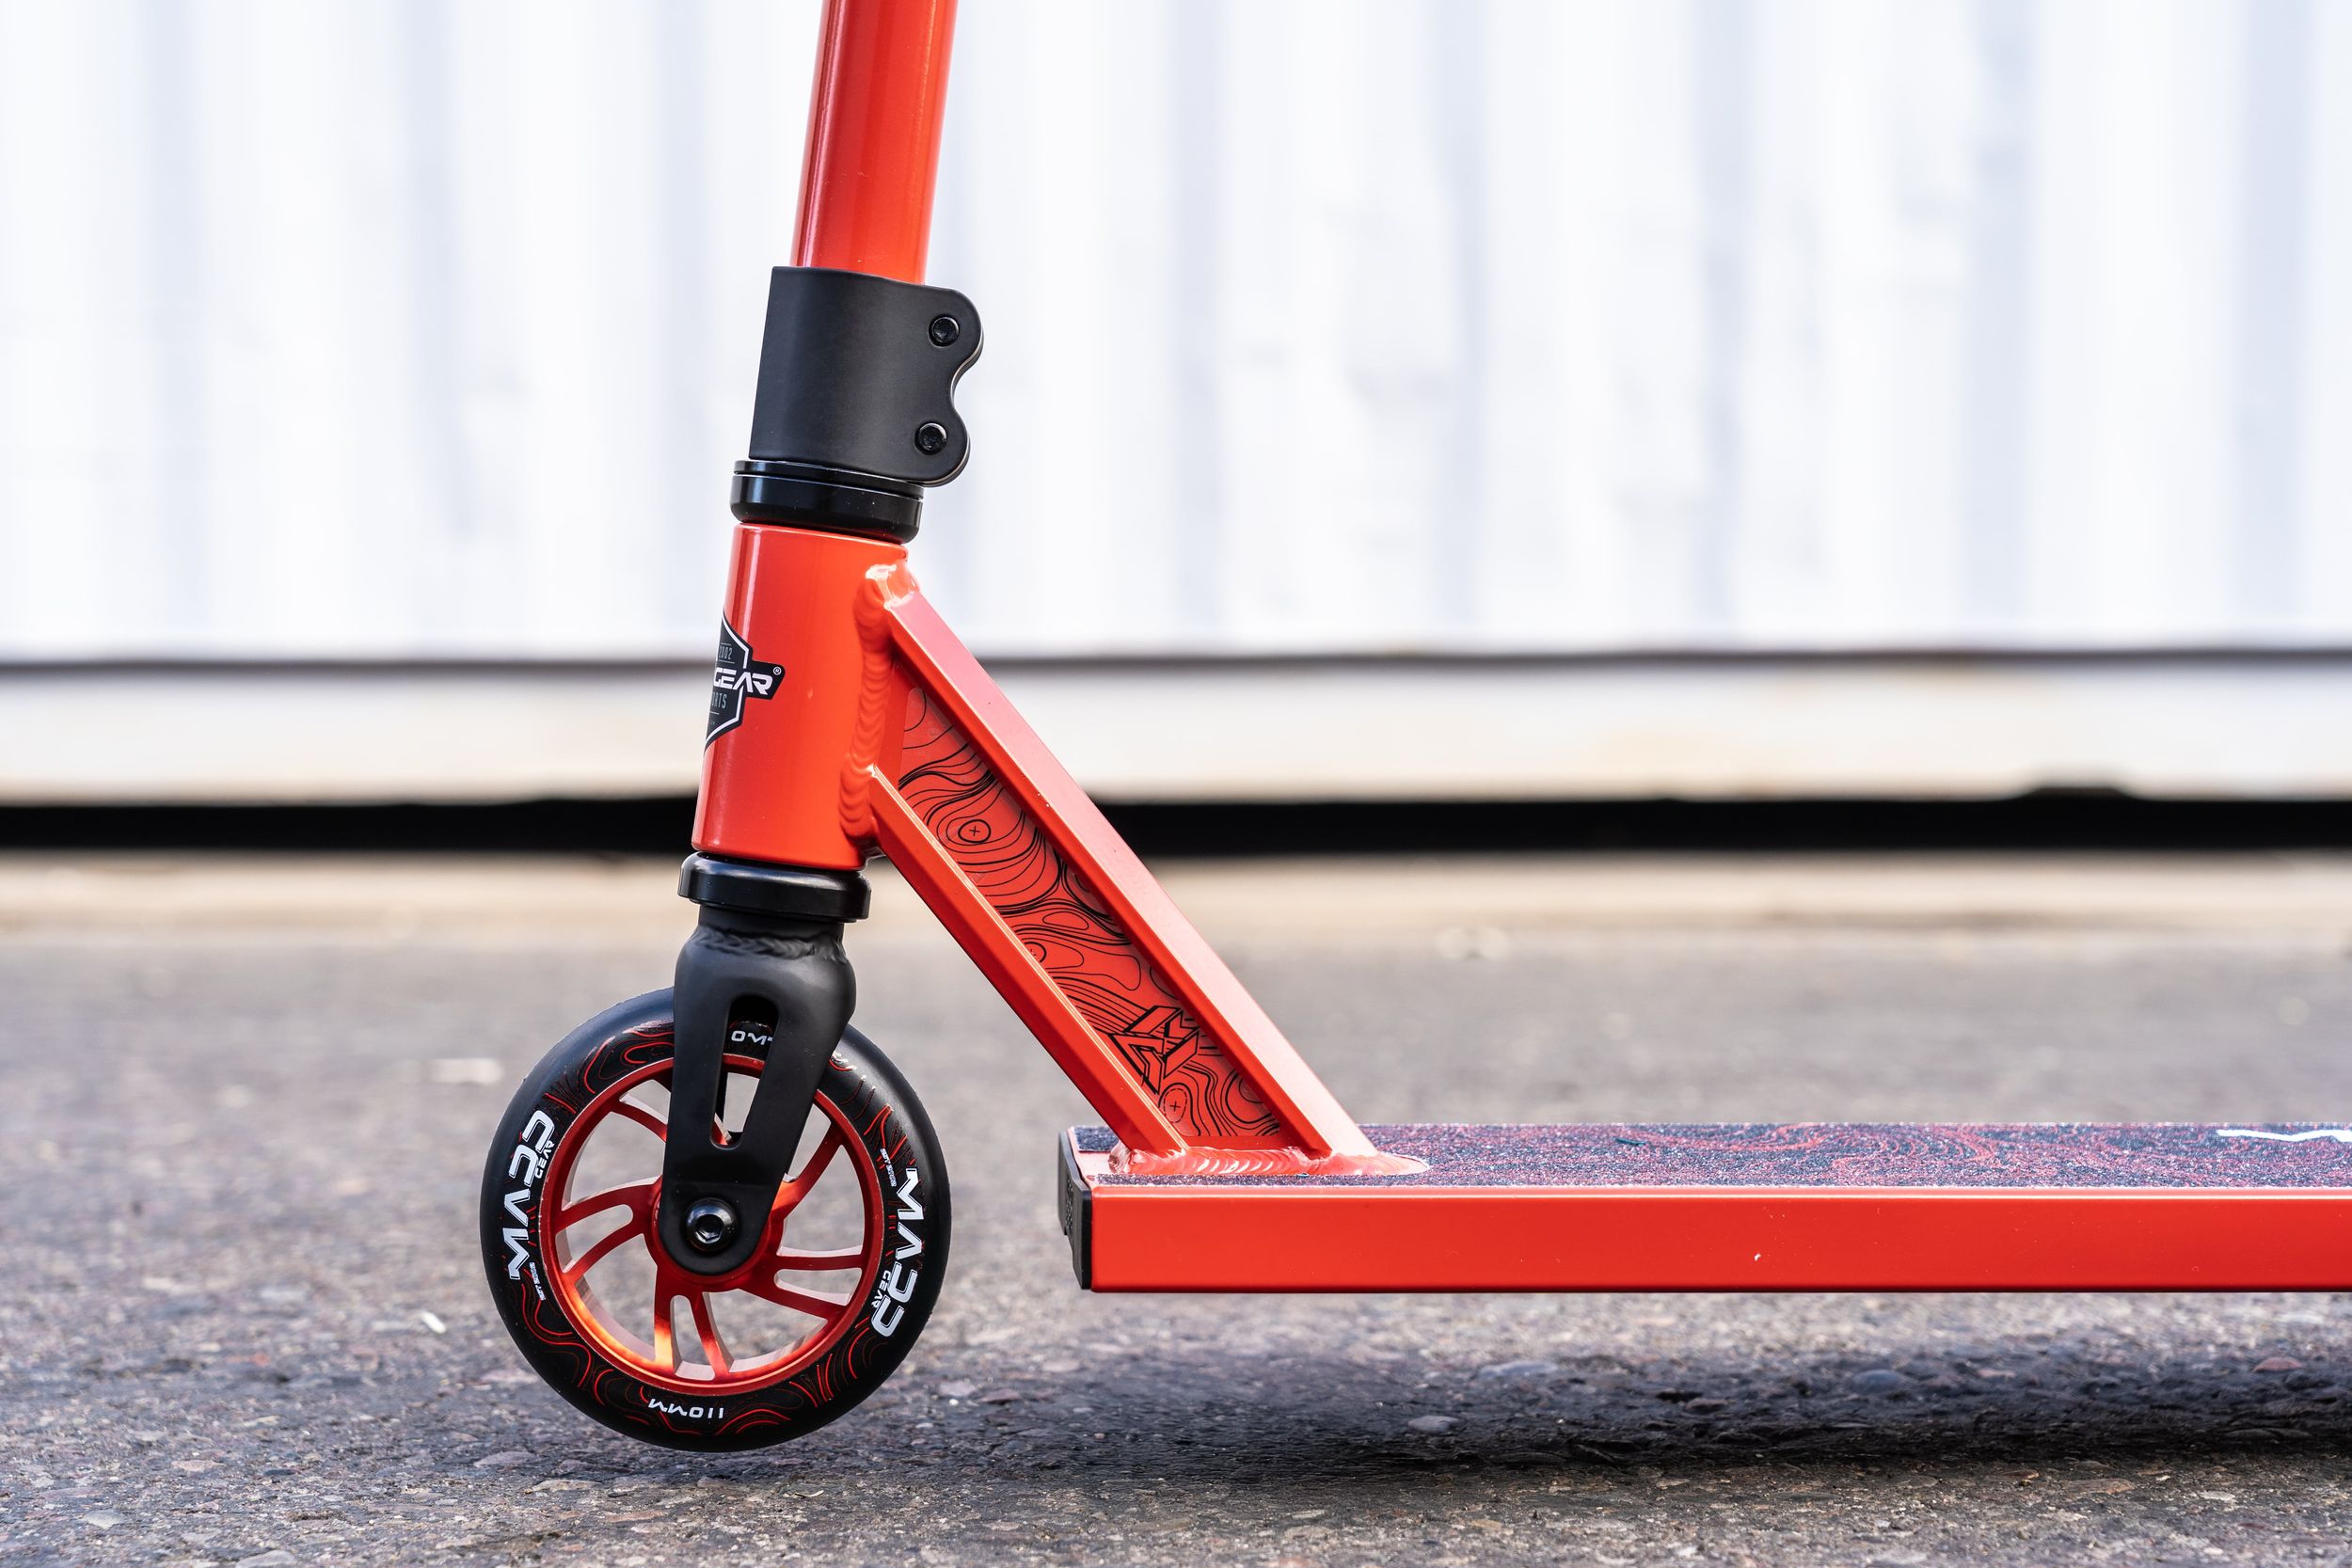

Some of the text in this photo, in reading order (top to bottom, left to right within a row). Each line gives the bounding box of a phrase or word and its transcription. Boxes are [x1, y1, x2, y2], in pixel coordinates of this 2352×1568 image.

[534, 1140, 555, 1180] GEAR
[502, 1110, 555, 1280] MADD
[871, 1167, 924, 1338] MADD
[871, 1270, 891, 1309] GEAR
[647, 1398, 724, 1419] 110MM
